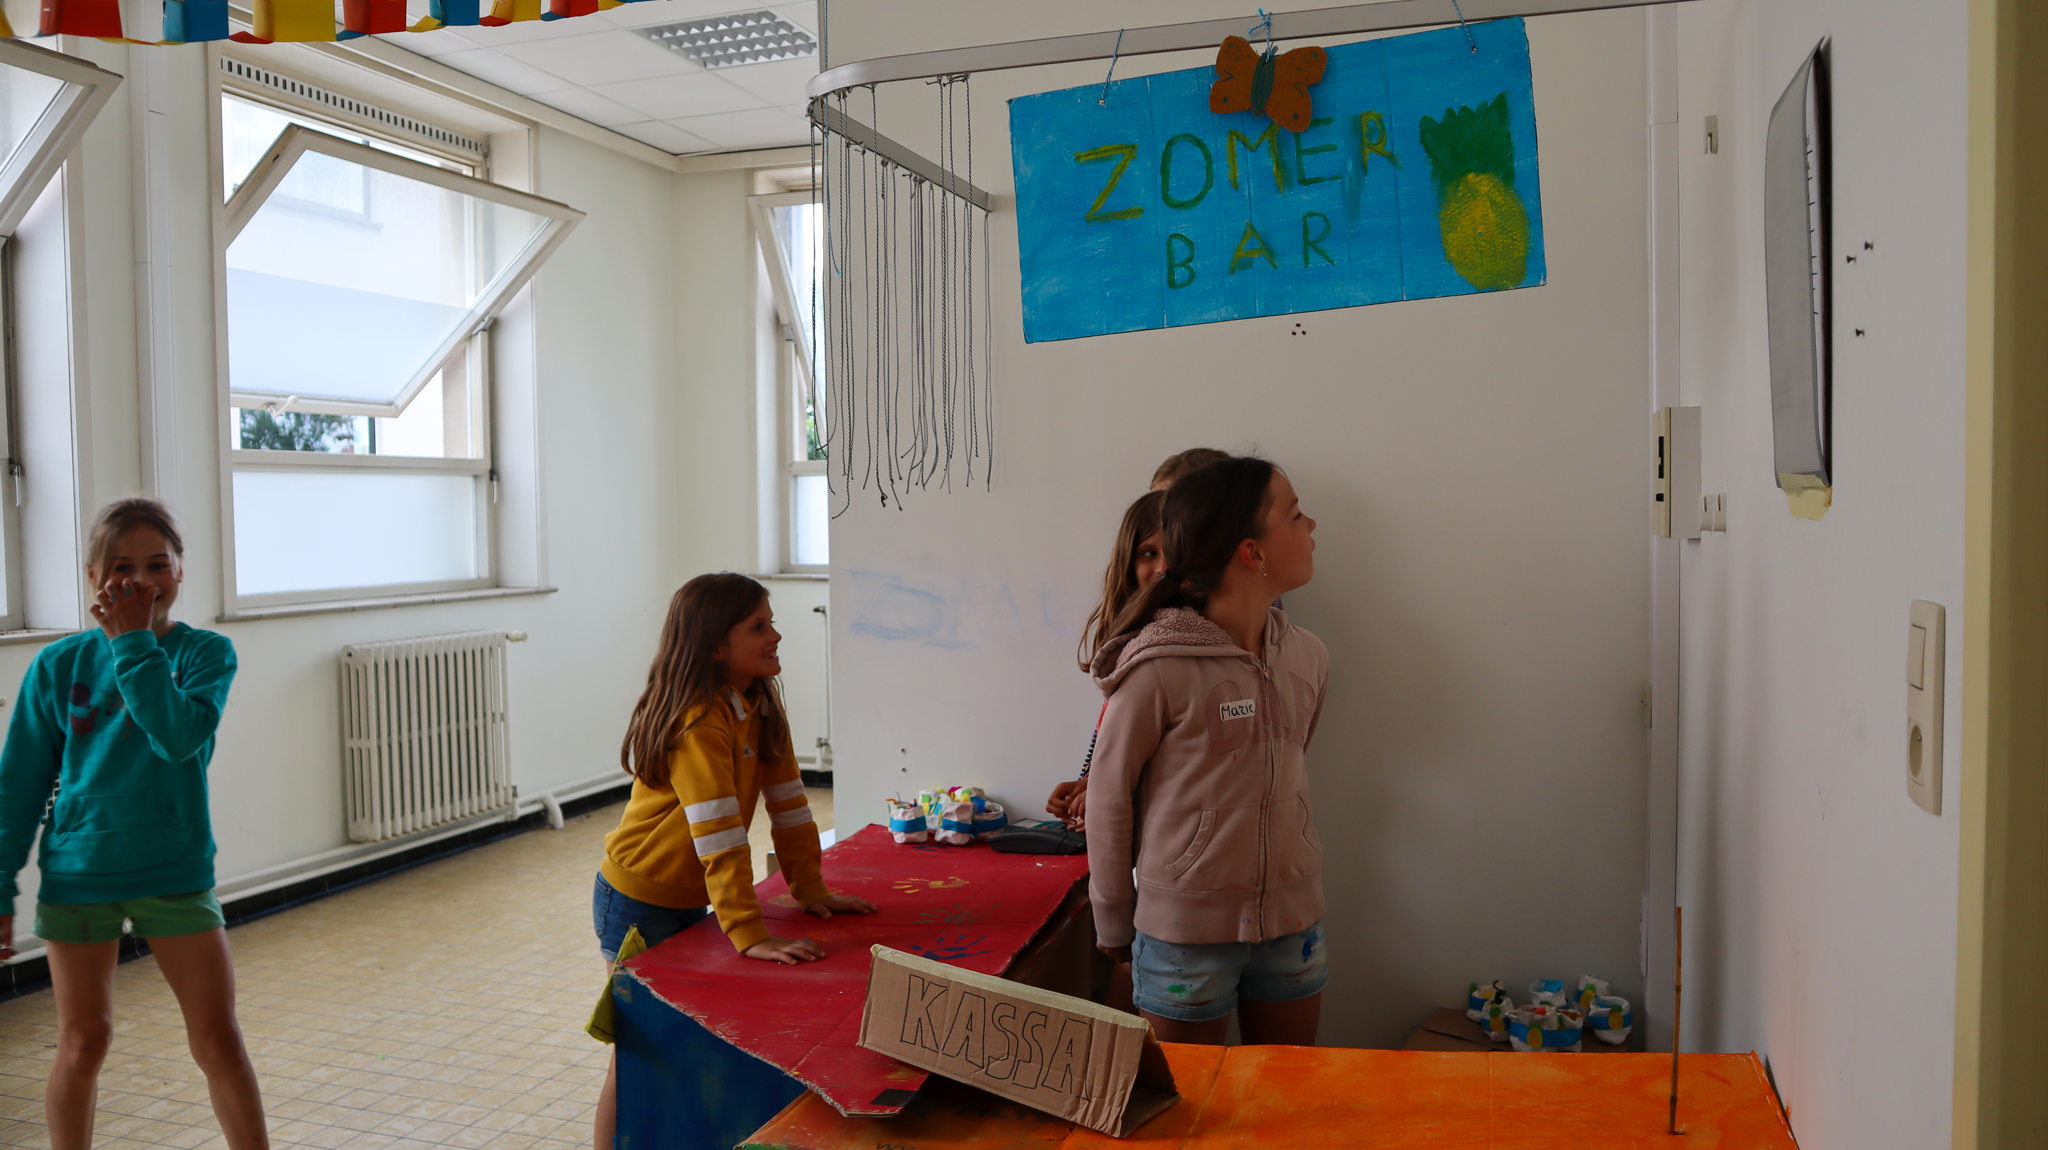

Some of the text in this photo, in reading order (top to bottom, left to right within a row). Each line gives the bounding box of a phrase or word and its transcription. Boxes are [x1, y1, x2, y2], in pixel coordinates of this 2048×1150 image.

[1074, 110, 1401, 223] ZOMER
[1166, 211, 1336, 289] BAR
[1221, 703, 1254, 719] Marie
[900, 973, 1094, 1100] KASSA
